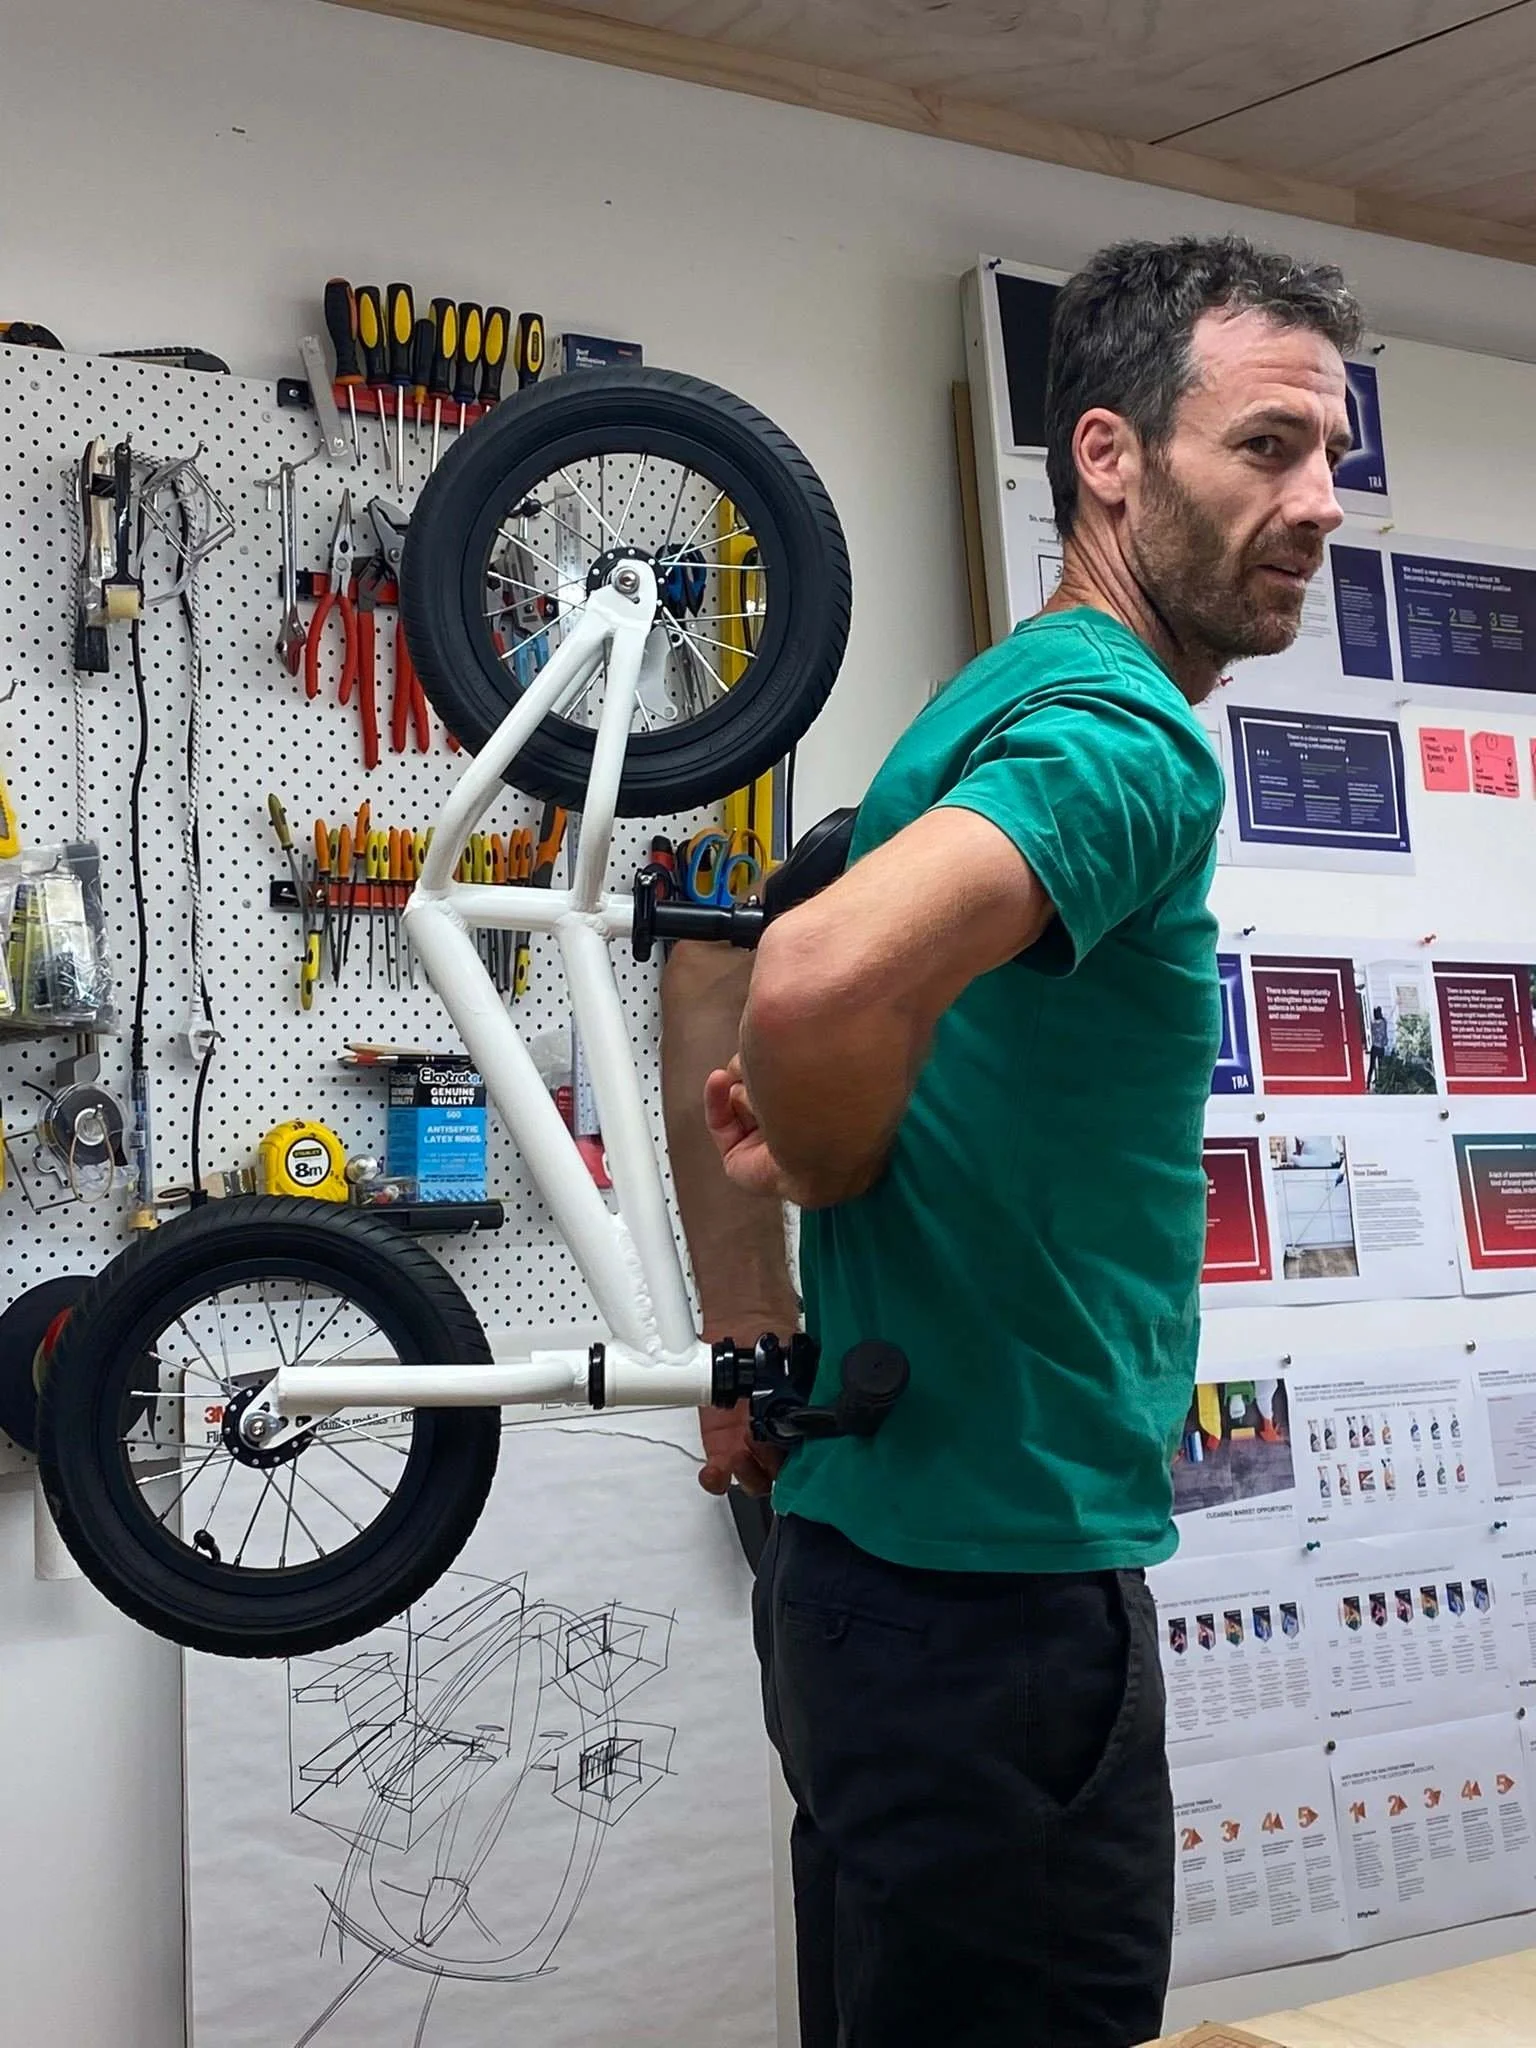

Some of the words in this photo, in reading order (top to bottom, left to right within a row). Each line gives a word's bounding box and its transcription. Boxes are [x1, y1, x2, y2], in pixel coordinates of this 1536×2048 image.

[1231, 1074, 1249, 1090] TRA
[430, 1087, 475, 1096] GENUINE
[431, 1096, 475, 1105] QUALITY
[427, 1125, 479, 1134] ANTISEPTIC
[424, 1135, 454, 1144] LATEX
[454, 1135, 482, 1144] RINGS
[295, 1162, 322, 1178] 8m
